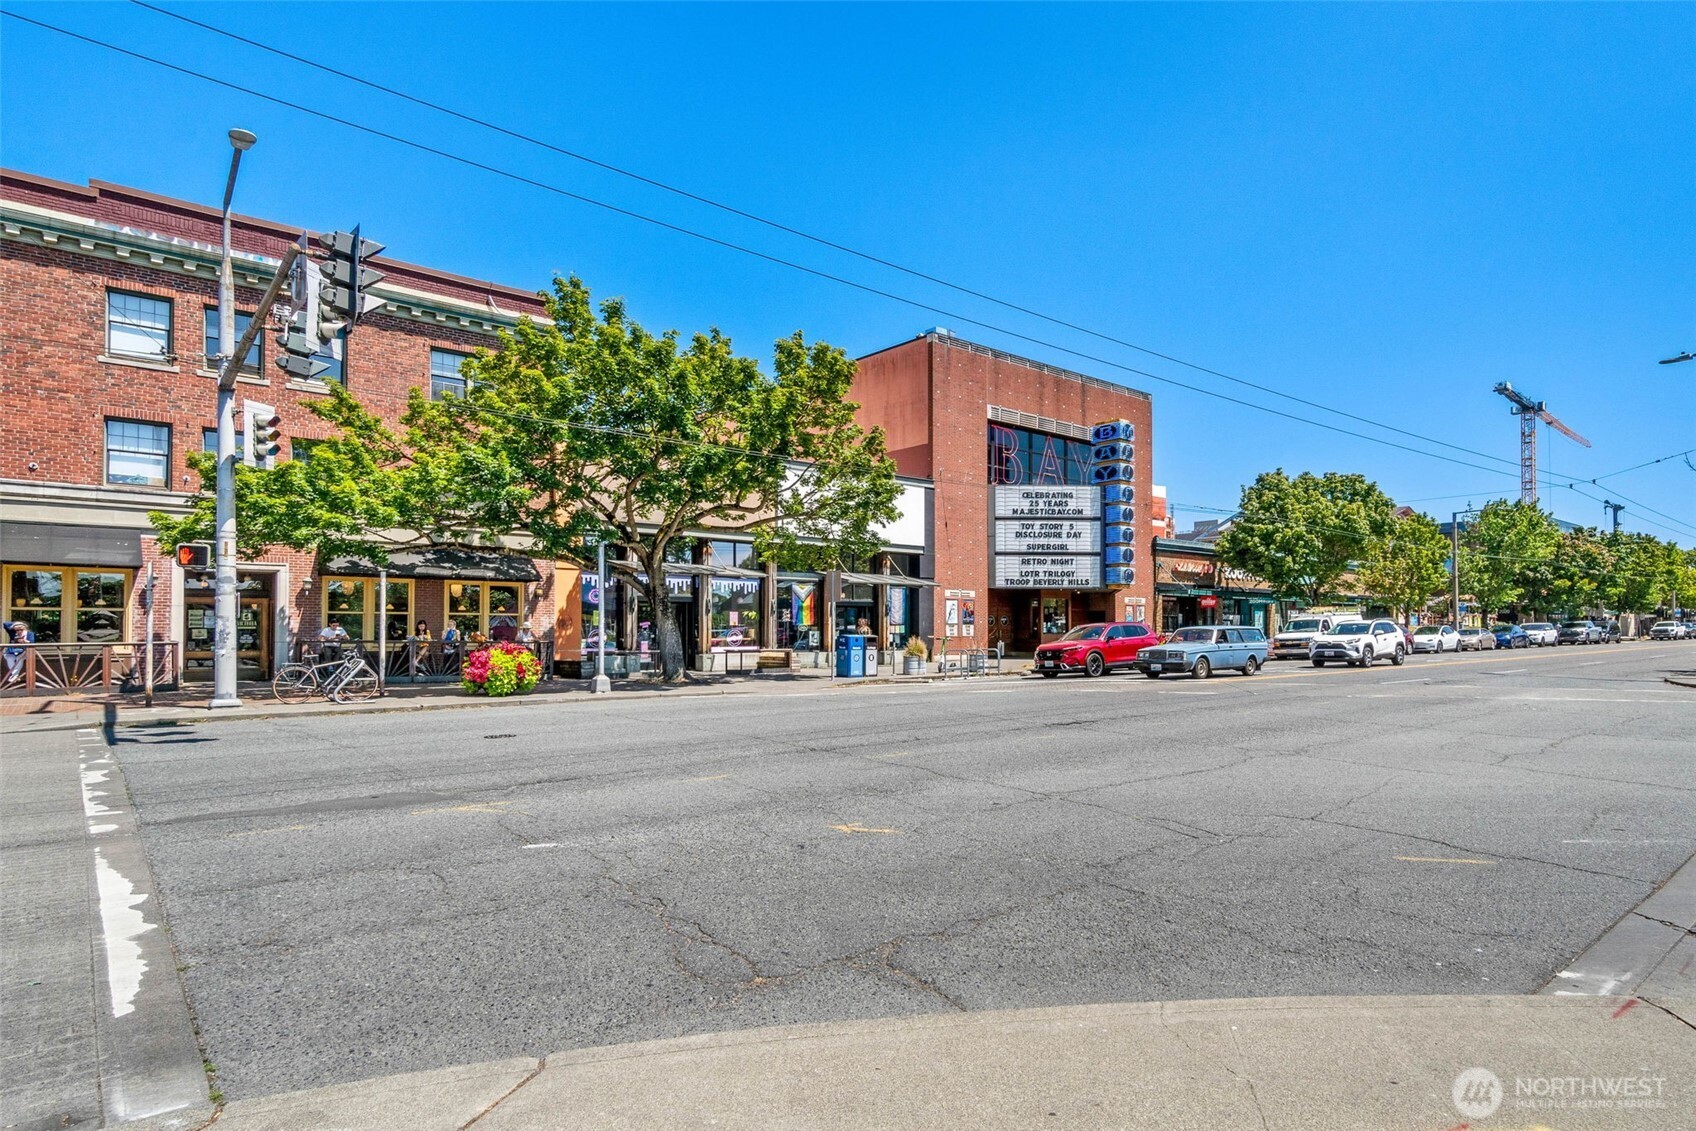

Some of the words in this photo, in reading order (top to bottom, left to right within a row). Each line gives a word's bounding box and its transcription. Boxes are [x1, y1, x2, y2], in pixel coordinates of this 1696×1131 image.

[991, 424, 1095, 487] BAY
[1022, 492, 1074, 500] CELEBRATING
[1028, 500, 1040, 508] 25
[1042, 500, 1068, 508] YEARS
[1012, 508, 1084, 516] MAJESTICBAY.COM
[1020, 522, 1034, 530] TOY
[1040, 522, 1064, 530] STORY
[1068, 522, 1074, 530] 5
[1014, 530, 1062, 538] DISCLOSURE
[1066, 530, 1082, 538] DAY
[1026, 542, 1070, 550] SUPERGIRL
[1020, 558, 1048, 566] RETRO
[1050, 558, 1074, 566] NIGHT
[1020, 570, 1040, 578] LOTR
[1042, 570, 1076, 578] TRILOGY
[1004, 578, 1030, 586] TROOP
[1068, 578, 1090, 586] HILLS
